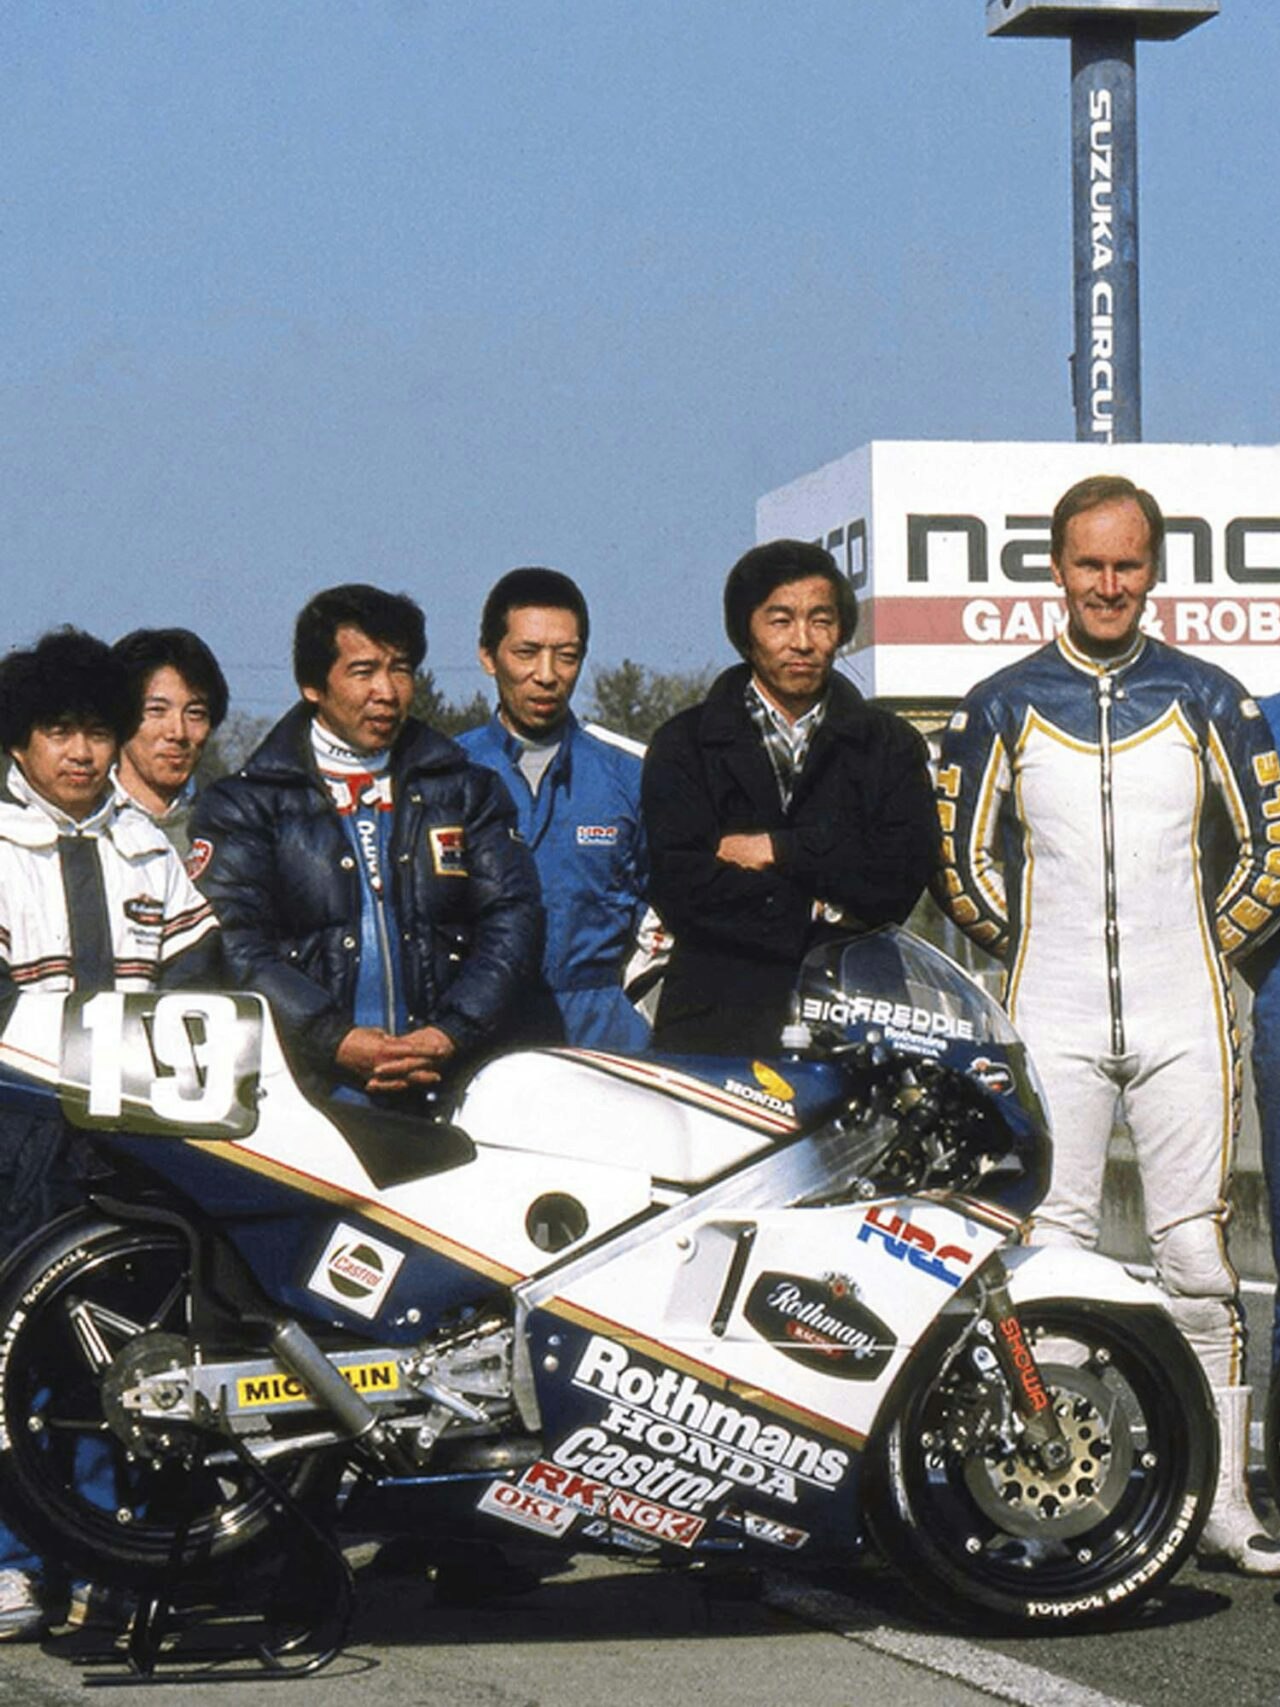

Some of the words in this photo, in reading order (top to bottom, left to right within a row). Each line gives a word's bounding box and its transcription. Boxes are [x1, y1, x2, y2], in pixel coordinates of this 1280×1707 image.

[1089, 88, 1112, 270] SUZUKA
[82, 991, 238, 1123] 19
[724, 1079, 795, 1117] HONDA
[856, 1206, 973, 1288] HRC
[767, 1282, 877, 1358] Rothmans
[1000, 1317, 1048, 1412] SHOWA
[574, 1336, 849, 1484] Rothmans
[525, 1460, 605, 1509] RK
[553, 1427, 734, 1512] Castrol
[600, 1402, 798, 1504] HONDA
[494, 1486, 563, 1525] OKI
[609, 1494, 690, 1541] NGK
[1107, 1494, 1198, 1602] MICHELIN
